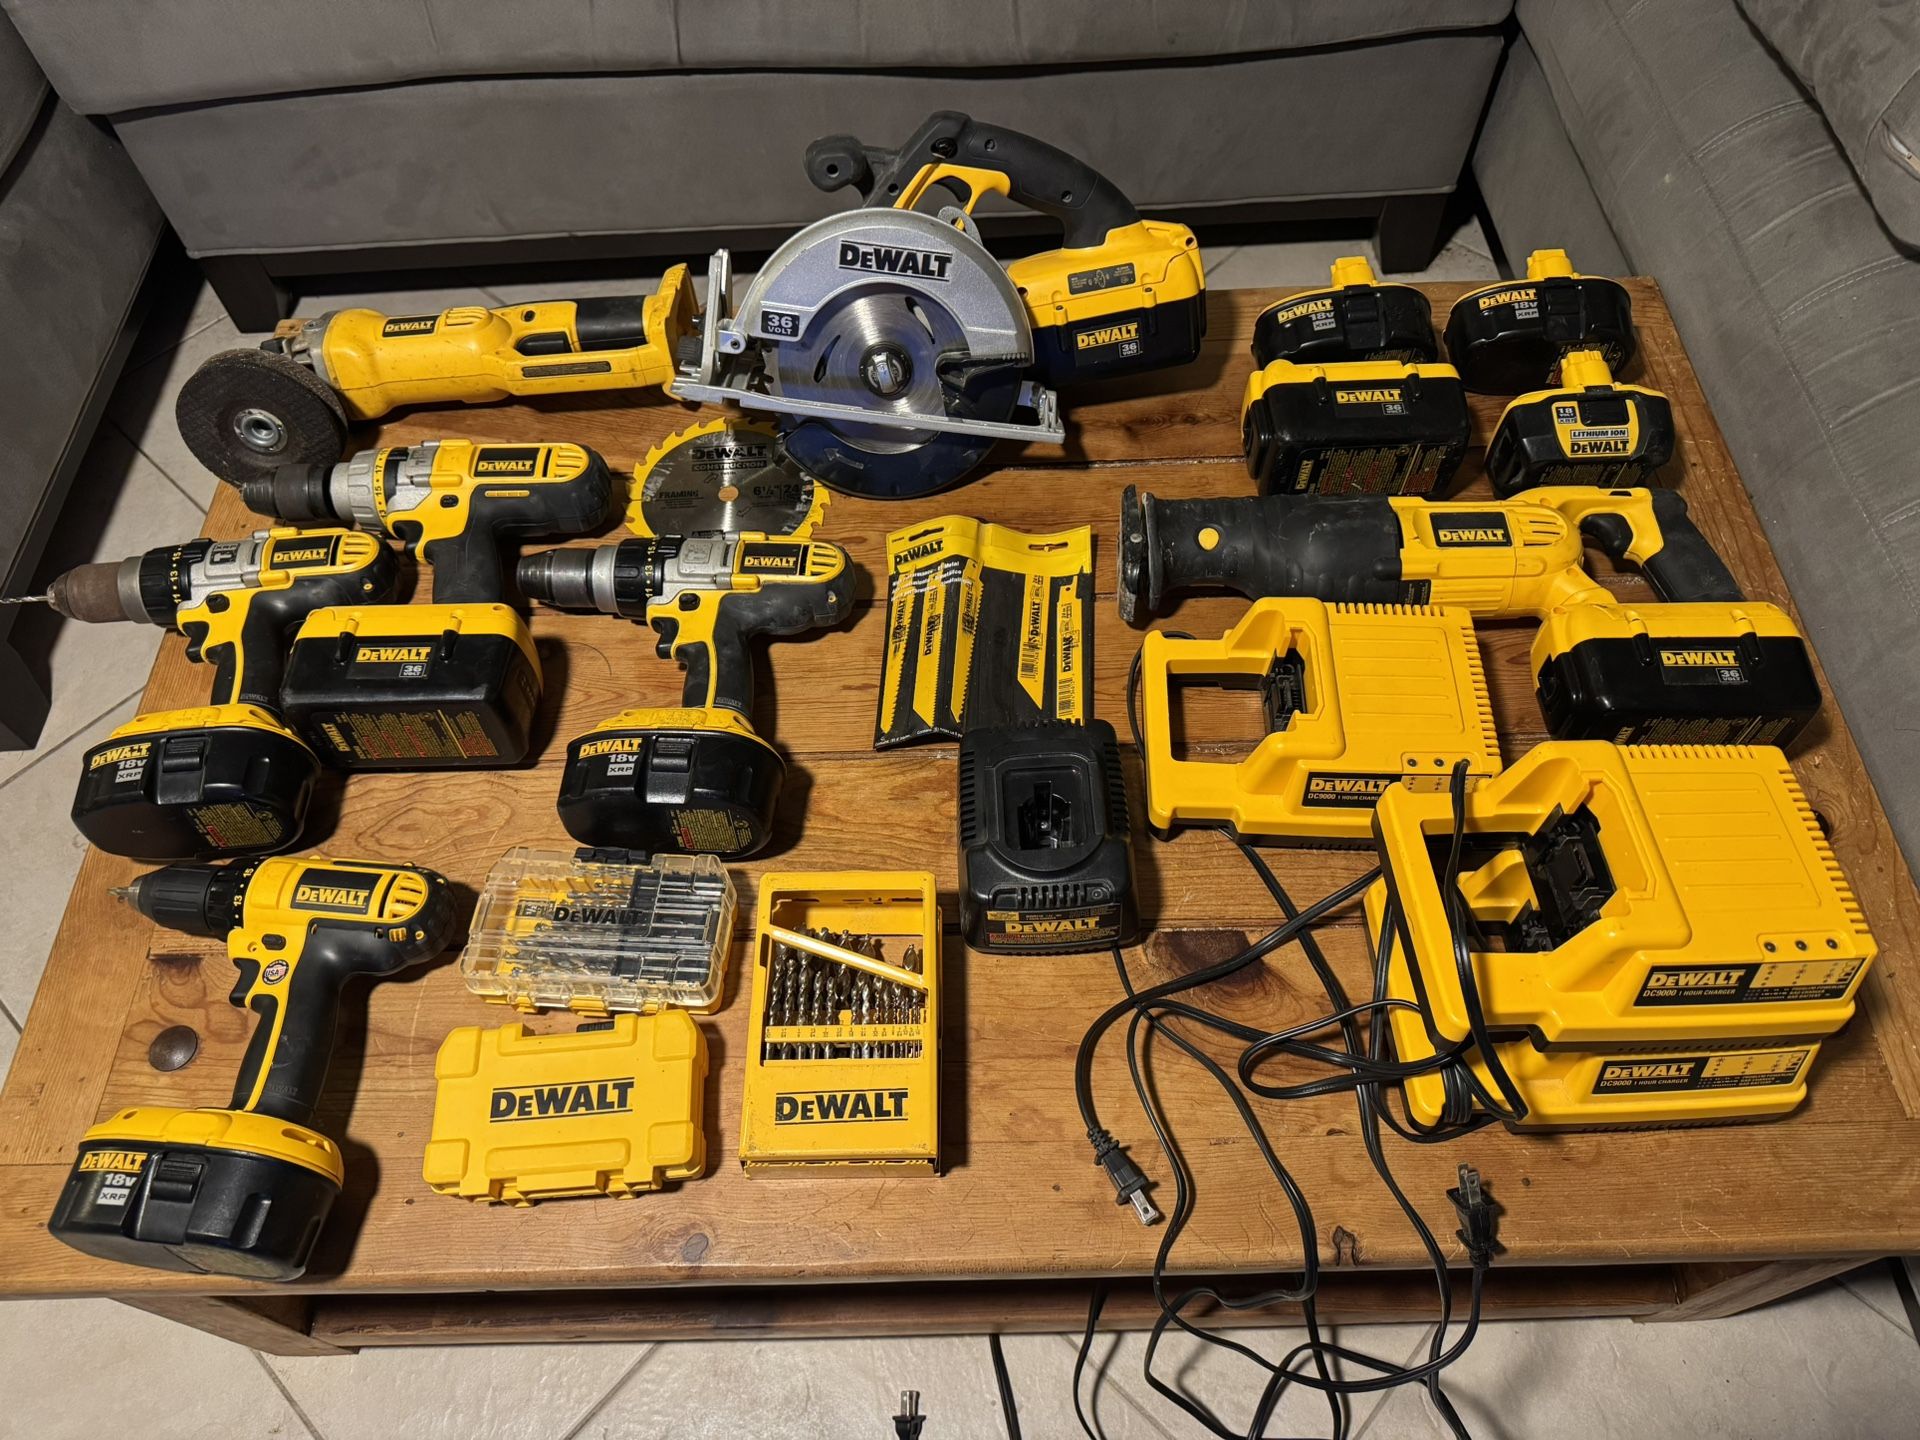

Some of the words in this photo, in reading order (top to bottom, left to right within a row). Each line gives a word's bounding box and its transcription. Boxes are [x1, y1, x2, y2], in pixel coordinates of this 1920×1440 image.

[839, 243, 952, 278] DEWALT
[1479, 289, 1537, 310] DEWALT
[1277, 299, 1334, 324] DEWALT
[384, 320, 434, 334] DEWALT
[767, 313, 793, 328] 36
[767, 325, 793, 336] VOLT
[1077, 324, 1138, 348] DEWALT
[1121, 342, 1138, 352] 36
[1336, 390, 1402, 402] DEWALT
[692, 445, 767, 460] DEWALT
[1570, 440, 1630, 454] DEWALT
[375, 464, 382, 474] 17
[477, 460, 533, 472] DEWALT
[692, 461, 767, 471] CONSTRUCTION
[375, 485, 382, 497] 15
[659, 490, 700, 498] FRAMING
[1440, 530, 1506, 543] DEWALT
[172, 551, 182, 561] 15
[273, 548, 328, 563] DEWALT
[647, 546, 656, 555] 15
[894, 540, 944, 565] DEWALT
[744, 556, 796, 568] DEWALT
[169, 570, 178, 582] 13
[645, 565, 653, 576] 13
[645, 588, 653, 598] 11
[1031, 601, 1041, 637] DEWALT
[357, 647, 431, 662] DEWALT
[1661, 652, 1737, 666] DEWALT
[403, 664, 423, 673] 36
[1720, 669, 1739, 678] 36
[580, 738, 643, 758] DEWALT
[91, 743, 152, 769] DEWALT
[117, 770, 142, 780] XRP
[608, 765, 633, 774] XRP
[1310, 779, 1390, 792] DEWALT
[233, 895, 242, 907] 13
[243, 868, 254, 878] 15
[297, 886, 370, 906] DEWALT
[554, 906, 643, 924] DEWALT
[1006, 917, 1100, 933] DEWALT
[265, 968, 280, 977] USA
[1646, 970, 1745, 988] DEWALT
[1642, 989, 1677, 997] DC9000
[1604, 1063, 1695, 1079] DEWALT
[491, 1081, 635, 1119] DEWALT
[776, 1091, 908, 1122] DEWALT
[79, 1153, 148, 1172] DEWALT
[100, 1191, 129, 1201] XRP
